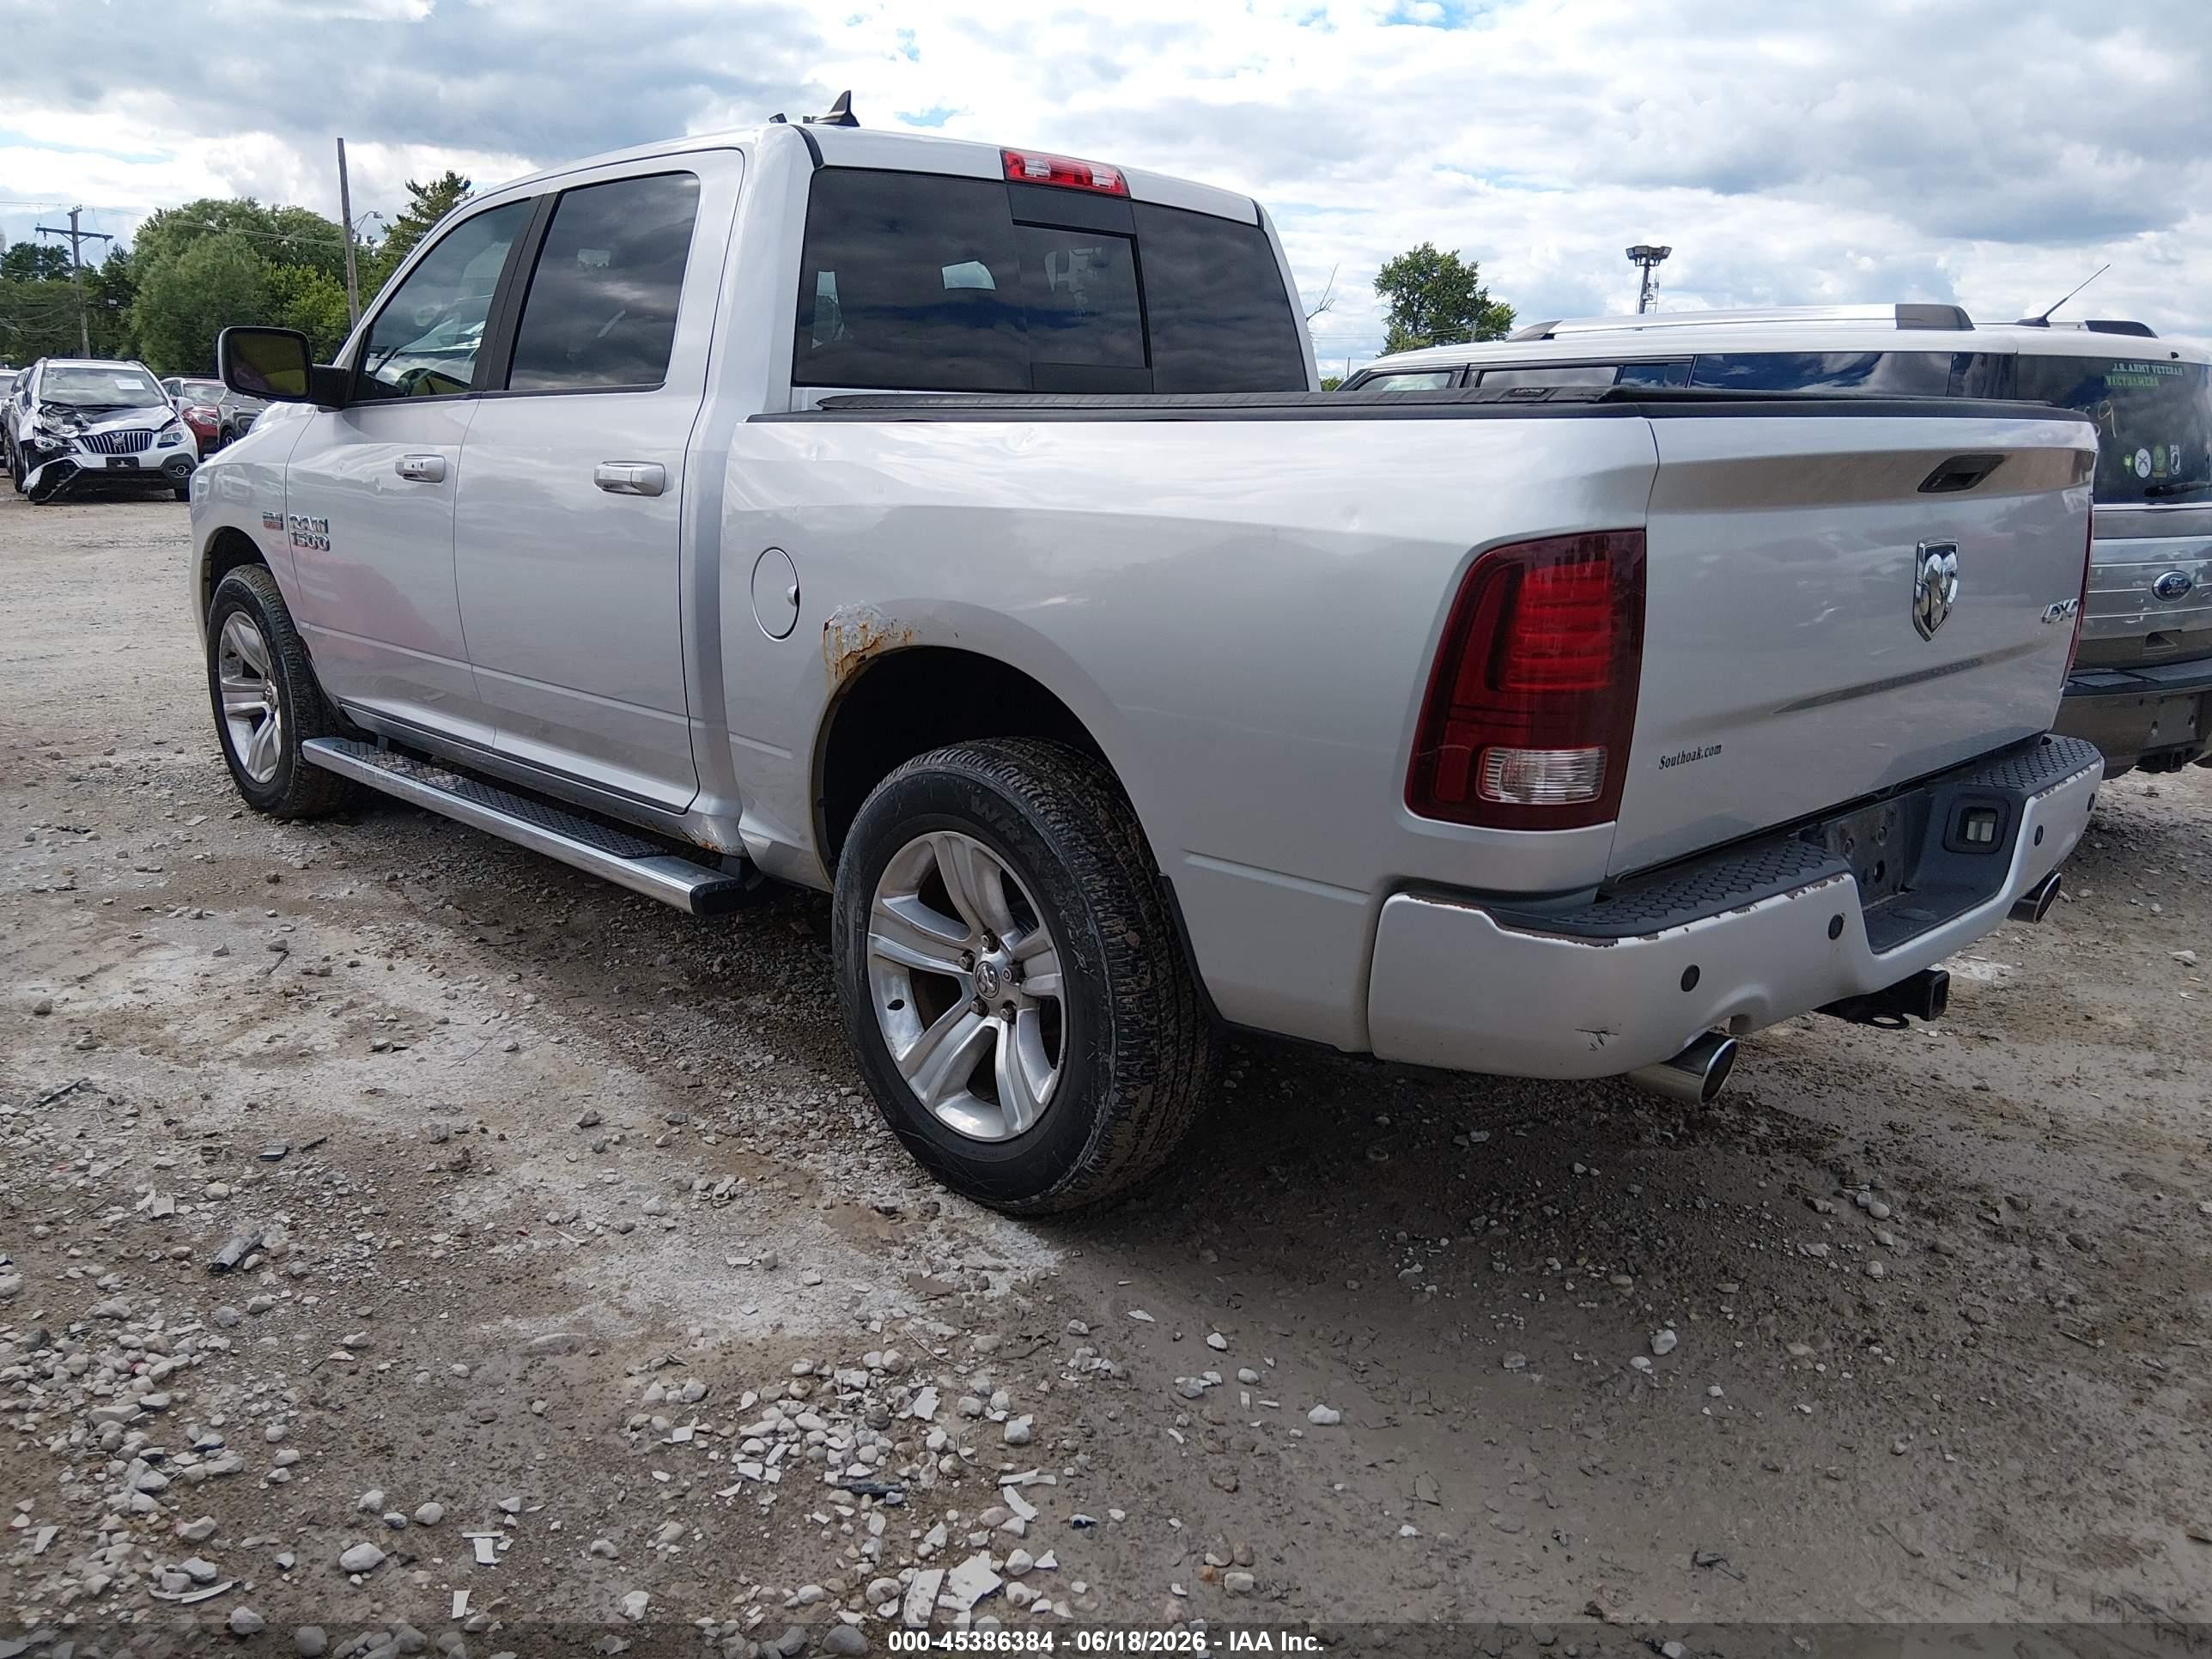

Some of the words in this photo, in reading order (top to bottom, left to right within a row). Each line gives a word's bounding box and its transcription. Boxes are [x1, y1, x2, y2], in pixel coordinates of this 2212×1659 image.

[2128, 363, 2149, 373] ARMY
[2150, 365, 2184, 376] VETERAN
[289, 514, 329, 533] RAM
[290, 531, 330, 551] 1500
[1658, 744, 1722, 769] Southoak.com
